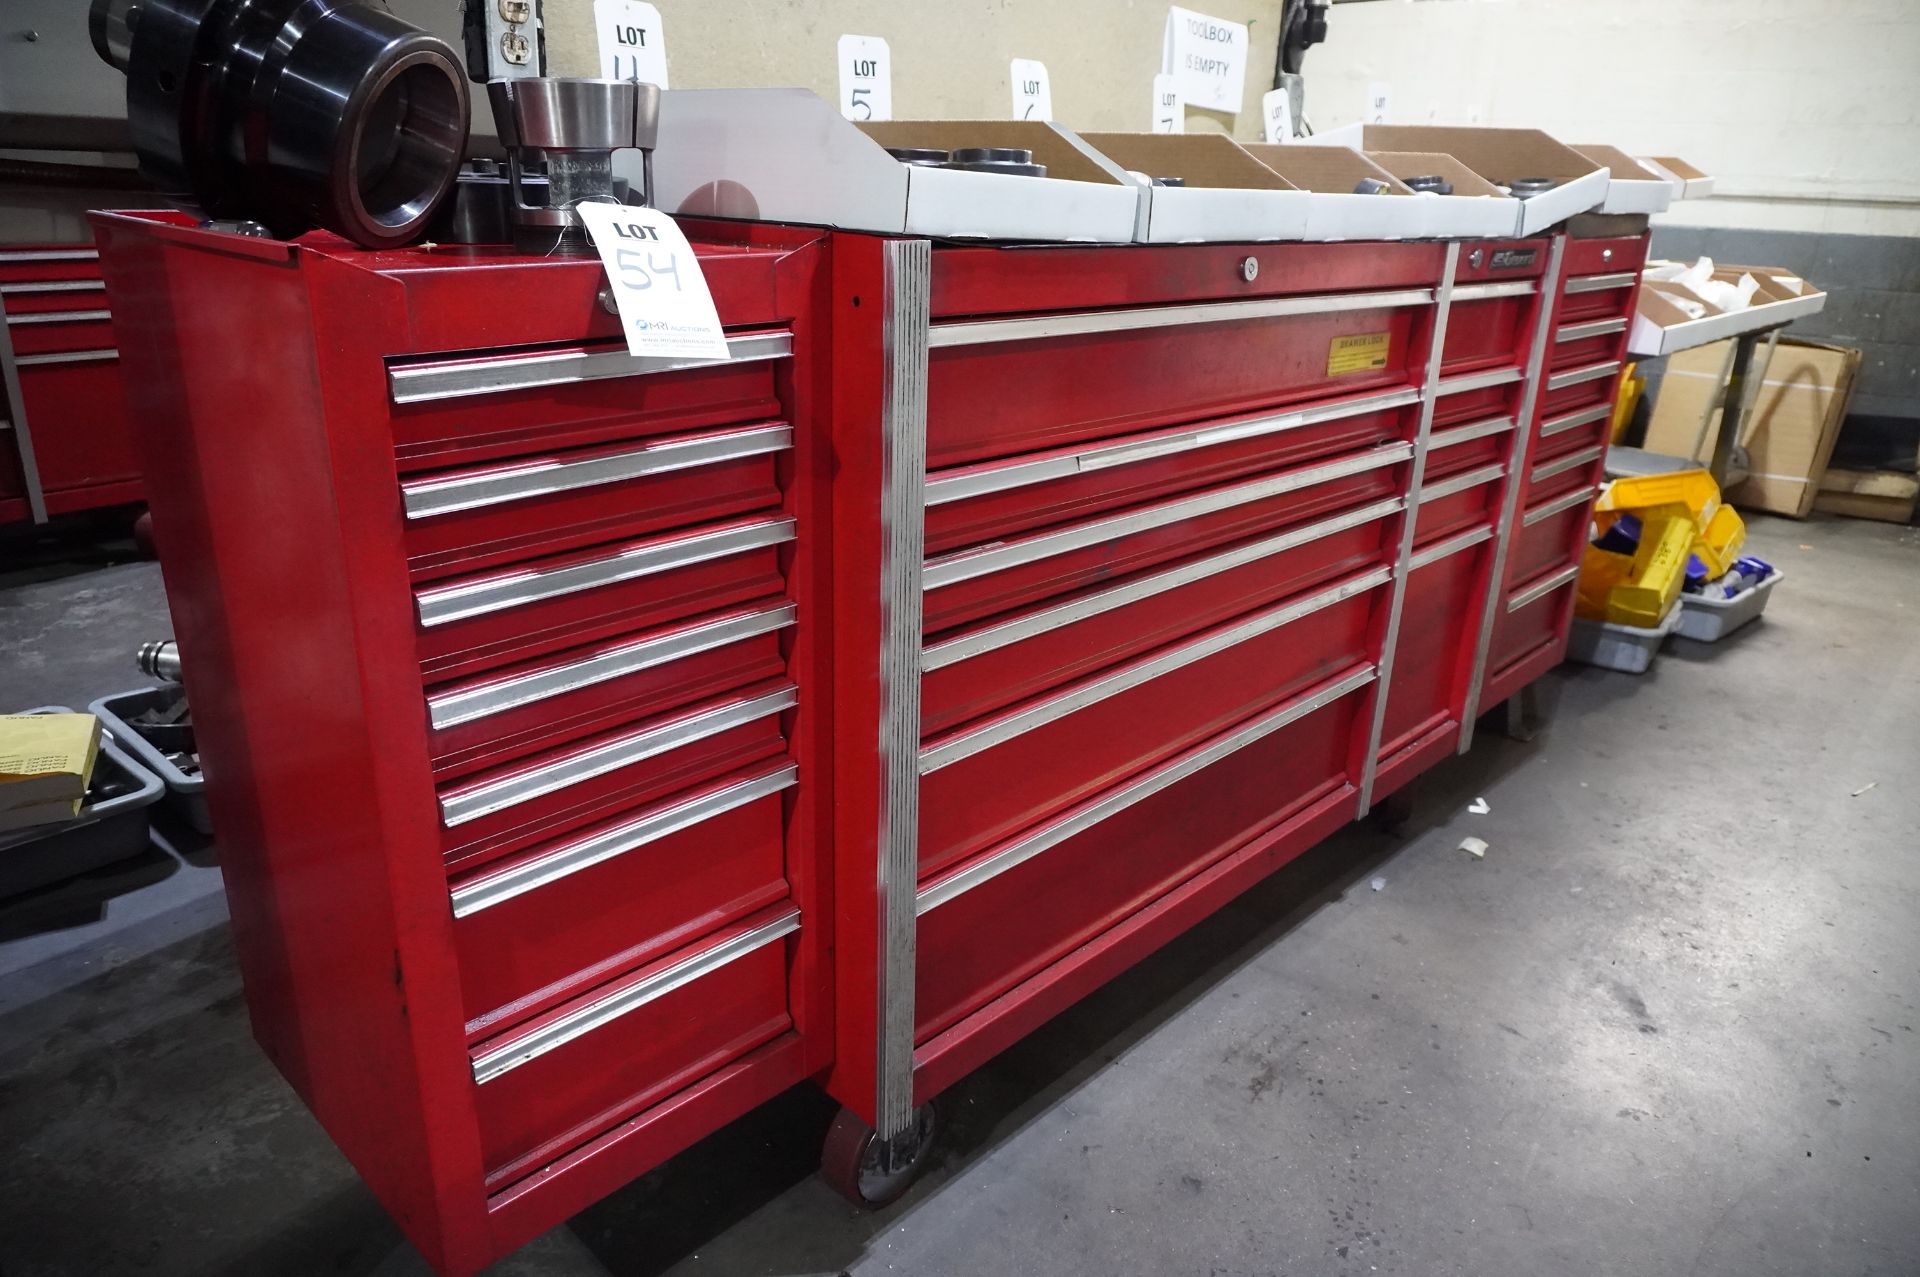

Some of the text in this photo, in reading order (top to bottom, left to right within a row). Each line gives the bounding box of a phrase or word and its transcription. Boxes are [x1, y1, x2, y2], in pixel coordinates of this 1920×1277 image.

[616, 24, 646, 47] LOT
[1187, 18, 1233, 44] TOOLBOX
[854, 60, 877, 77] LOT
[1194, 56, 1229, 77] EMPTY
[1023, 80, 1040, 95] LOT
[851, 89, 871, 120] 5
[1162, 93, 1176, 106] LOT
[613, 222, 659, 241] LOT
[616, 248, 682, 291] 54
[649, 321, 669, 331] MRI
